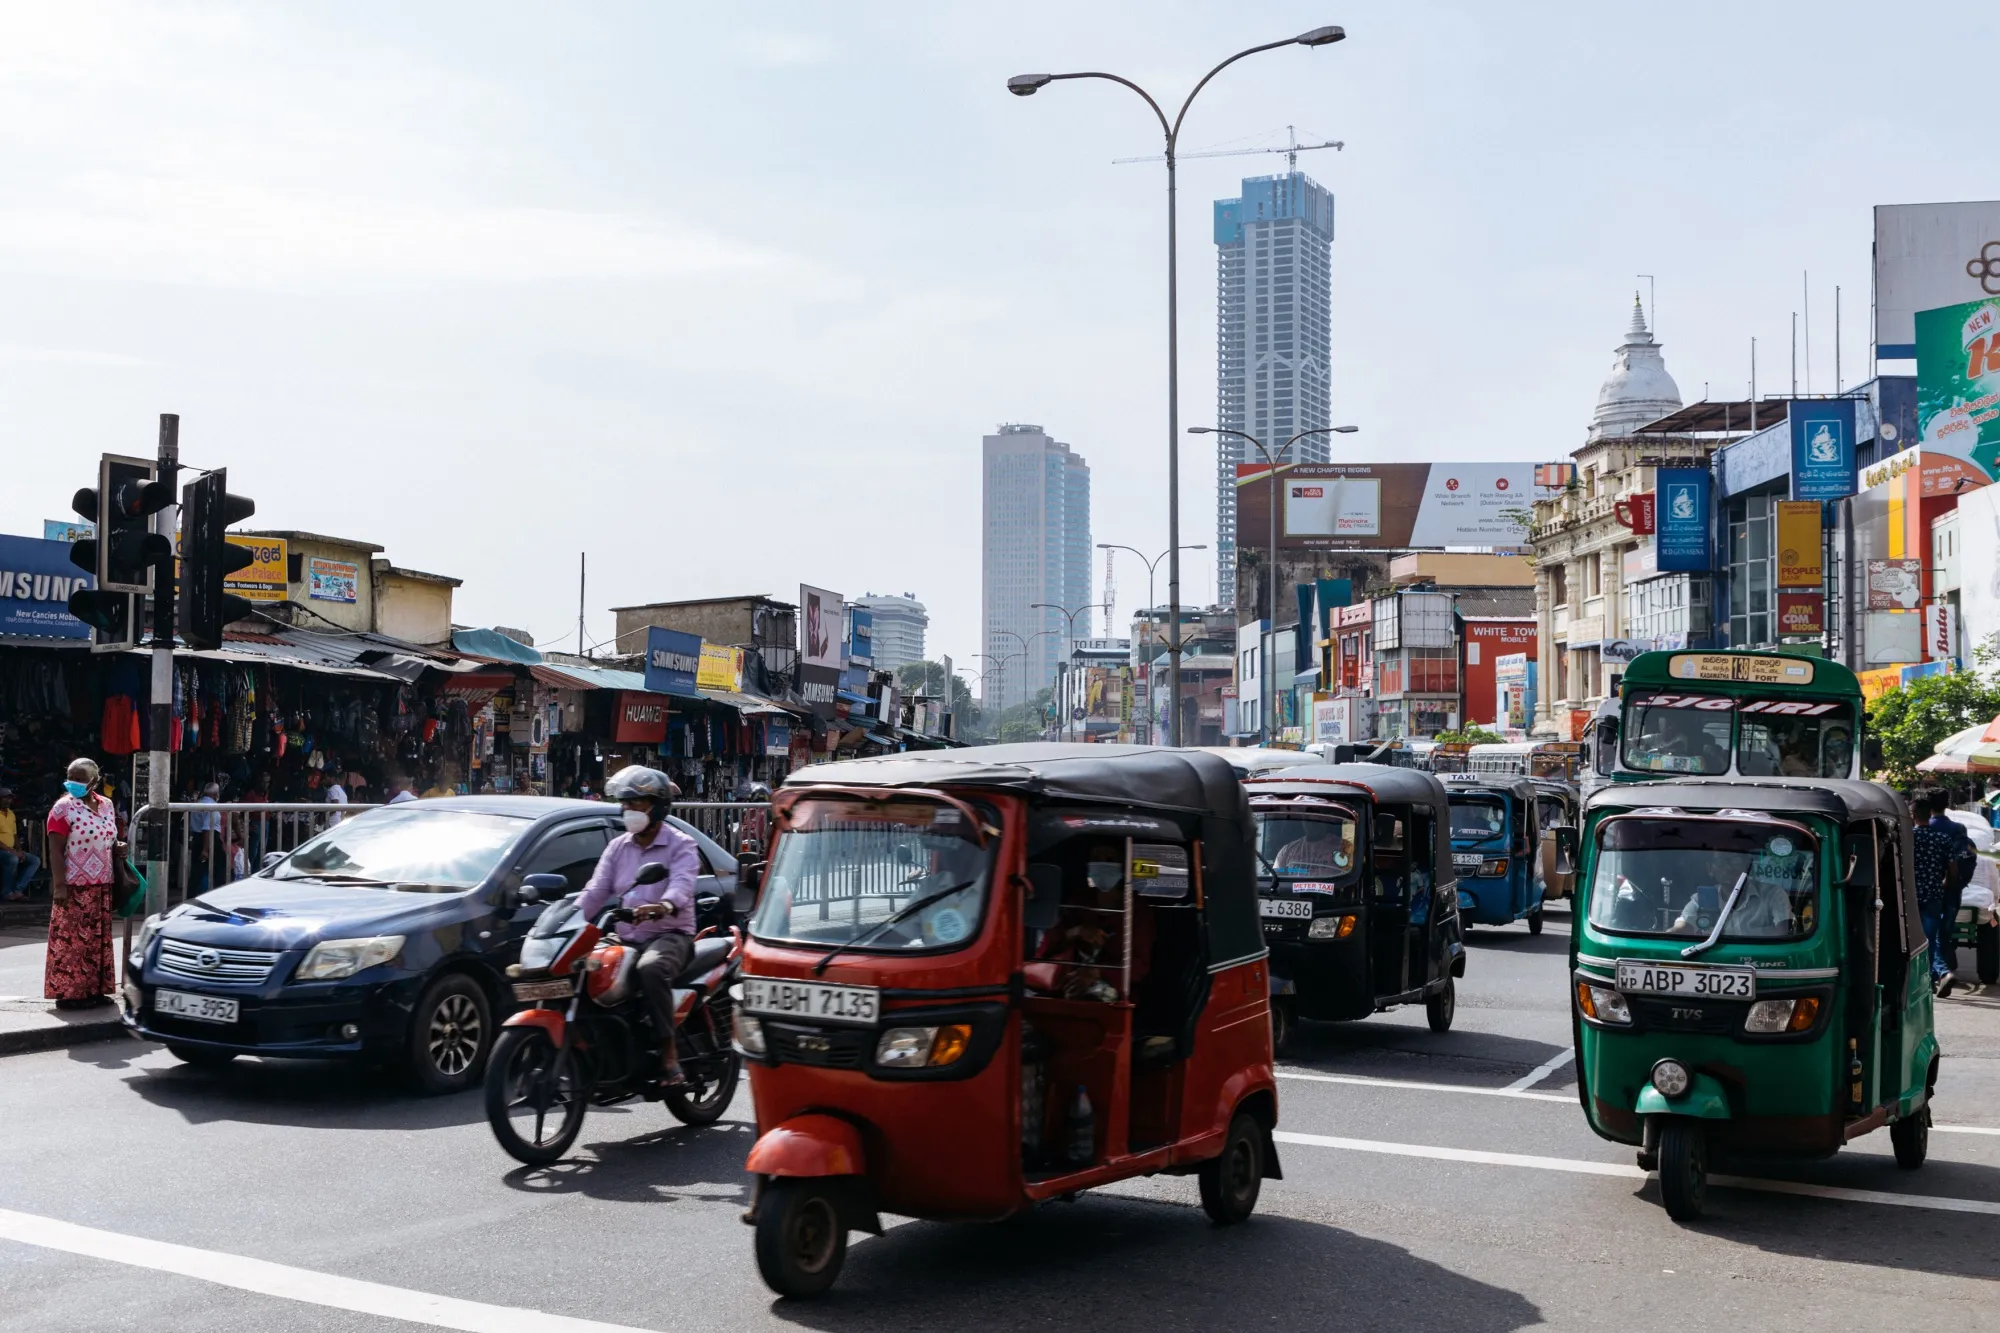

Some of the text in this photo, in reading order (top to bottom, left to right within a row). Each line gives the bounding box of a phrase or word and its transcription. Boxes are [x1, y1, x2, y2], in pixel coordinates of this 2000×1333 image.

[1967, 311, 1991, 333] NEW
[252, 567, 282, 580] Palace
[1781, 567, 1821, 575] PEOPLE'S
[16, 610, 31, 618] New
[1788, 605, 1813, 615] ATM
[1782, 614, 1809, 624] CDM
[1473, 627, 1507, 636] WHITE
[1791, 623, 1820, 631] KIOSK
[1937, 606, 1949, 655] Bata
[1073, 640, 1107, 649] TO LET
[653, 650, 697, 673] SAMSUNG
[1733, 657, 1749, 680] 138
[1755, 674, 1778, 682] FORT
[803, 682, 835, 703] SAMSUNG
[1461, 855, 1482, 865] 1268
[1319, 883, 1335, 892] TAXI
[1277, 902, 1311, 917] 6386
[1264, 923, 1284, 932] TVS
[1744, 960, 1787, 968] KING
[1620, 970, 1750, 997] WP ABP 3023
[766, 984, 812, 1013] ABH
[819, 989, 876, 1019] 7135
[1671, 1007, 1703, 1020] TVS
